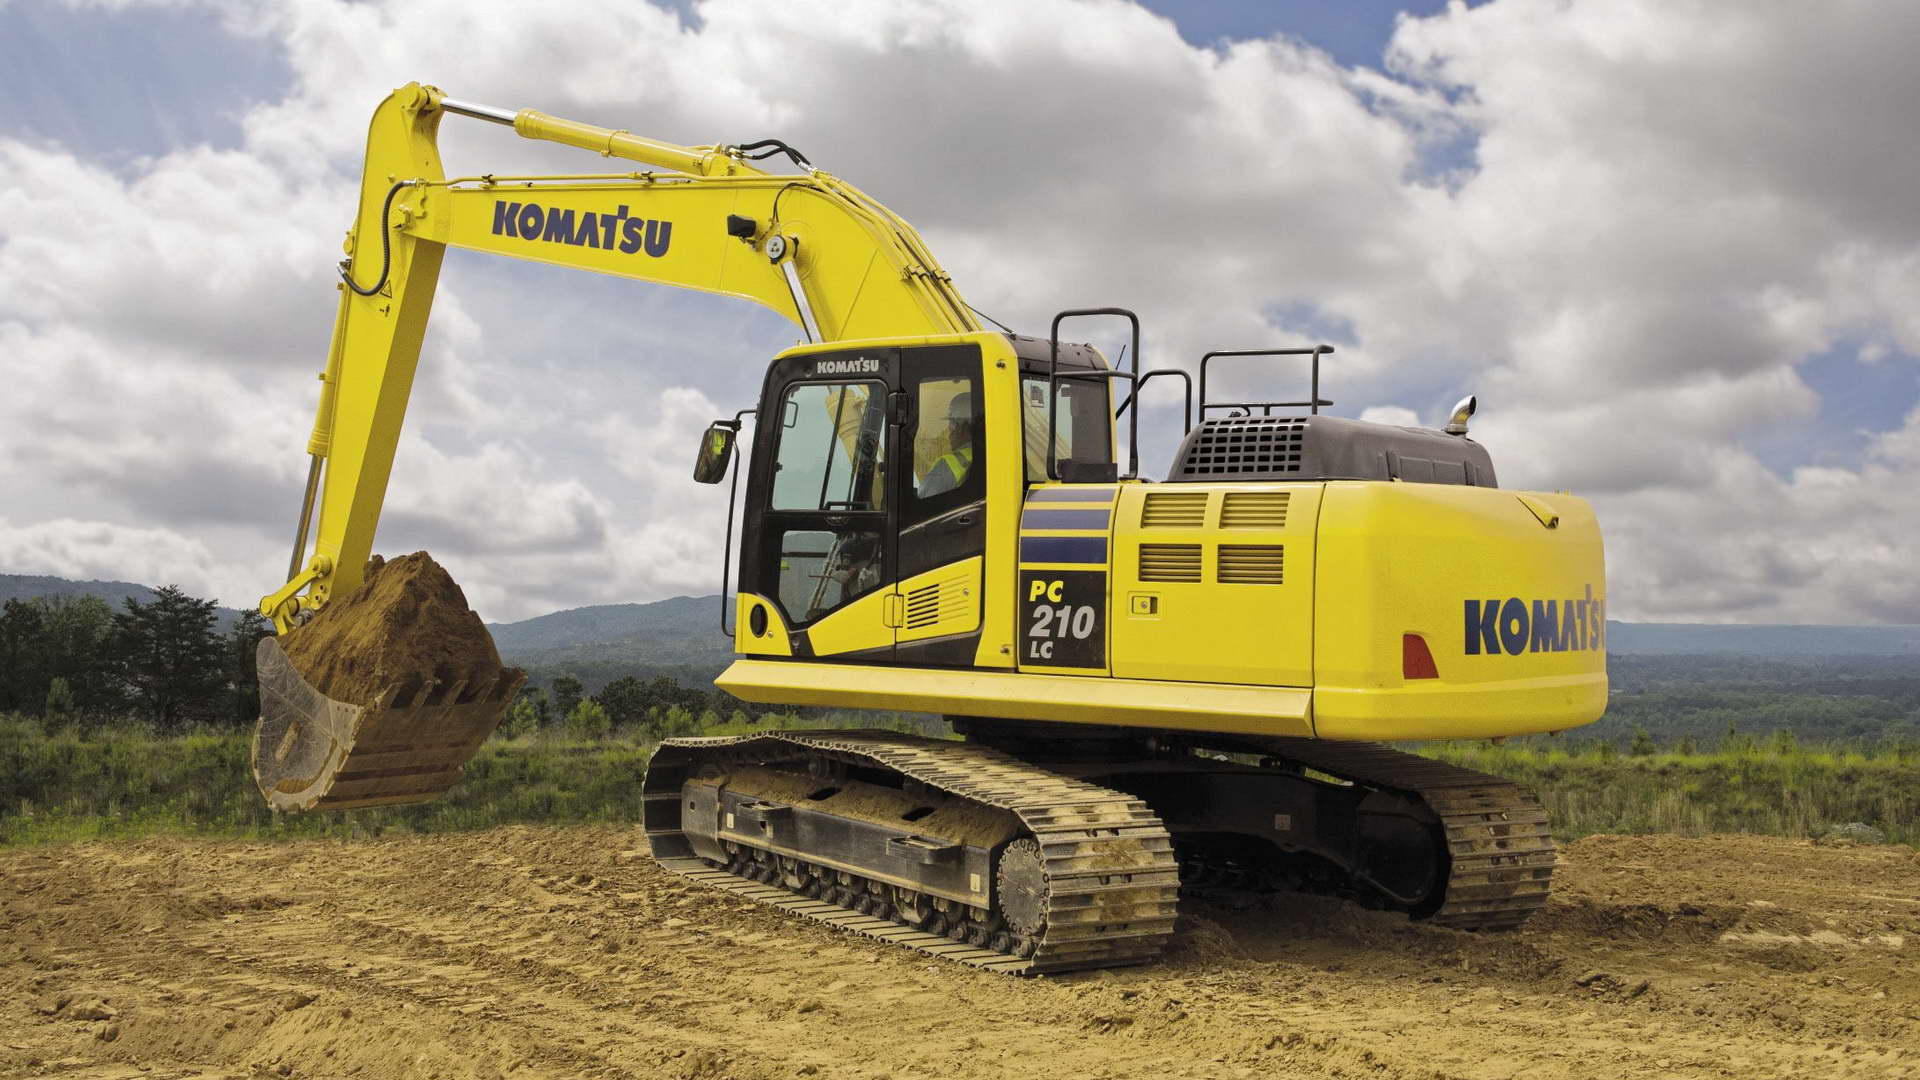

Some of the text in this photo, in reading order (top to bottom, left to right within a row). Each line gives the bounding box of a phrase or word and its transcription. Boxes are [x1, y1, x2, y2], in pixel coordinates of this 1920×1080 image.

[492, 200, 673, 258] KOMATSU
[817, 356, 879, 374] KOMATSU
[1029, 580, 1064, 603] PC
[1029, 604, 1095, 640] 210
[1030, 640, 1054, 659] LC
